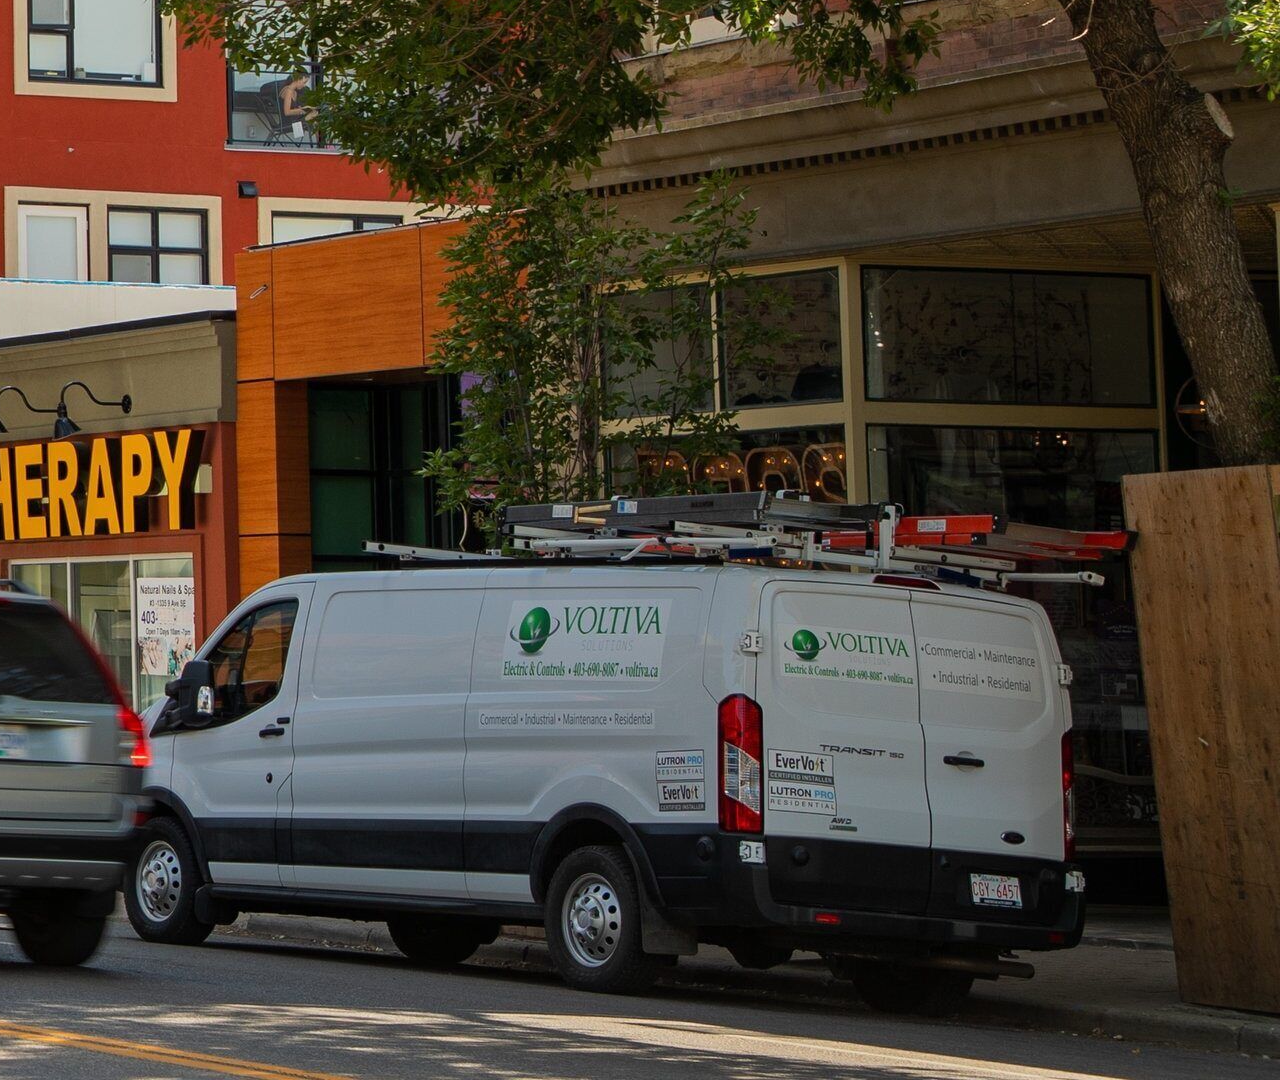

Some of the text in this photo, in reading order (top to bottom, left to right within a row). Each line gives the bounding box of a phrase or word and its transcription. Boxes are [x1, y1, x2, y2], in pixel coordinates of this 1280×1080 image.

[140, 585, 195, 596] Natural Nails & Spa
[563, 606, 663, 634] VOLTIVA
[581, 639, 634, 652] SOLUTIONS
[826, 631, 910, 657] VOLTIVA
[924, 643, 1036, 667] Commercial Maintenance
[503, 661, 659, 678] Electric & Controls 403-690-8087 voltiva.ca
[783, 663, 808, 675] Electric
[808, 664, 813, 675] &
[814, 665, 840, 678] Controls
[938, 670, 1032, 692] Industrial Residential
[480, 713, 653, 726] Commercial Industrial Maintenance Residential
[819, 744, 886, 757] TRANSIT
[657, 754, 703, 766] LUTRON PRO
[657, 767, 703, 775] RESIDENTIAL
[770, 786, 834, 800] LUTRON PRO
[770, 799, 835, 810] RESIDENTIAL
[830, 817, 852, 825] AWD
